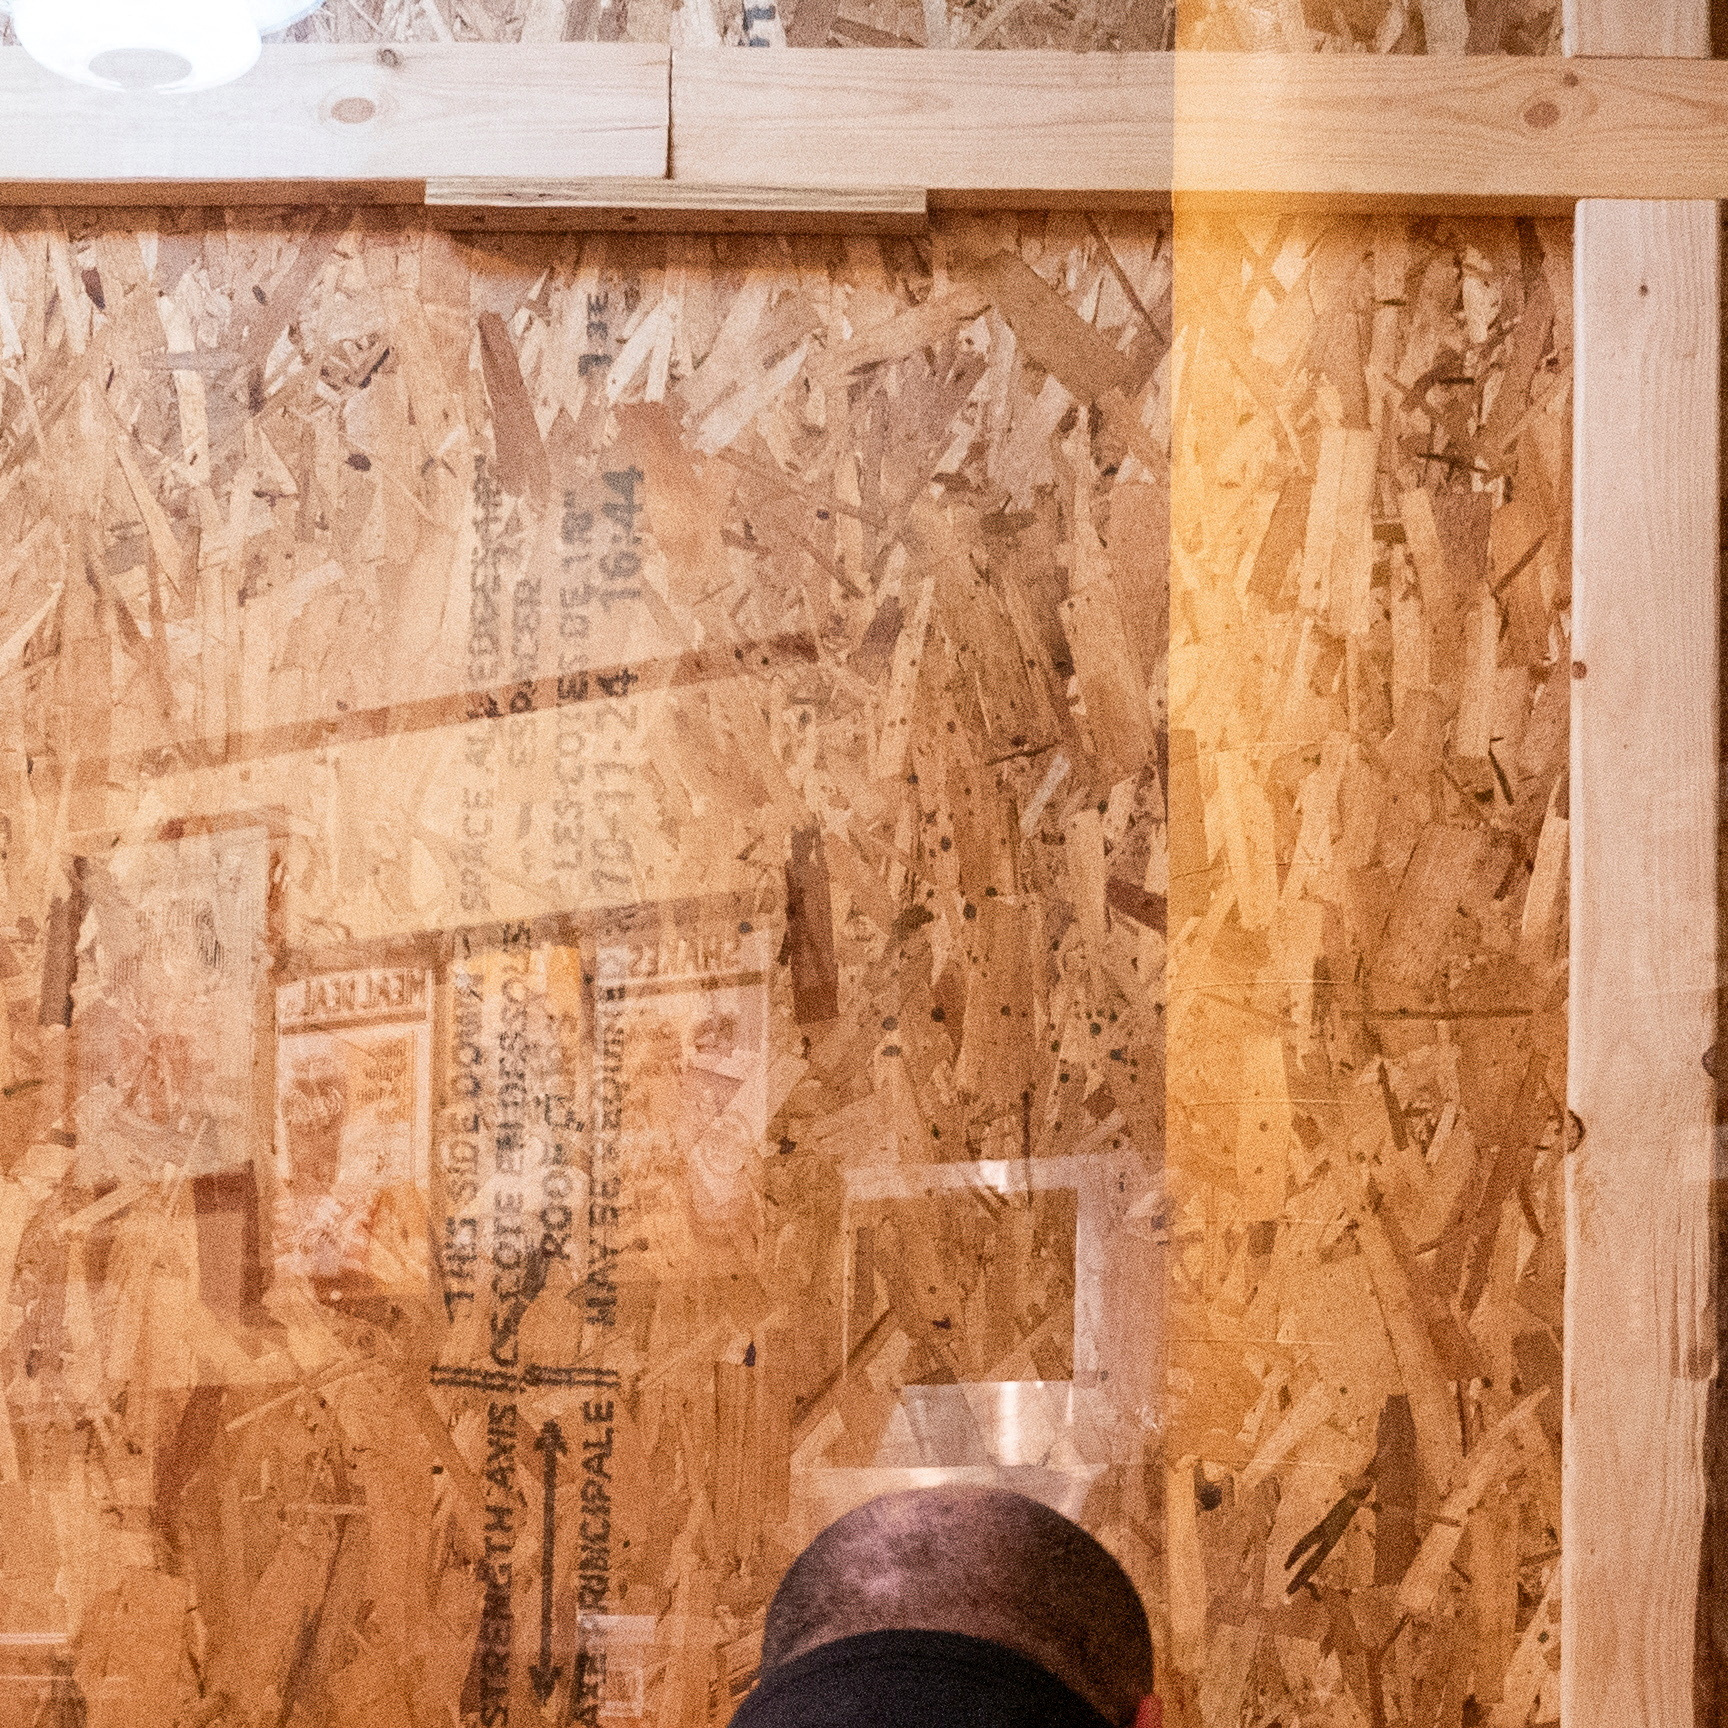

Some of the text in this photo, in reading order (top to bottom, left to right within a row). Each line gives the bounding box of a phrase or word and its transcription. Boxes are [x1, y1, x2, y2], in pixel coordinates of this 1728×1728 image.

[599, 465, 646, 612] 16:44
[465, 697, 500, 770] ALL
[459, 787, 495, 911] SPACE
[553, 800, 585, 872] LES
[491, 1192, 524, 1301] COTE
[479, 1402, 518, 1728] STRENGTH AXIS
